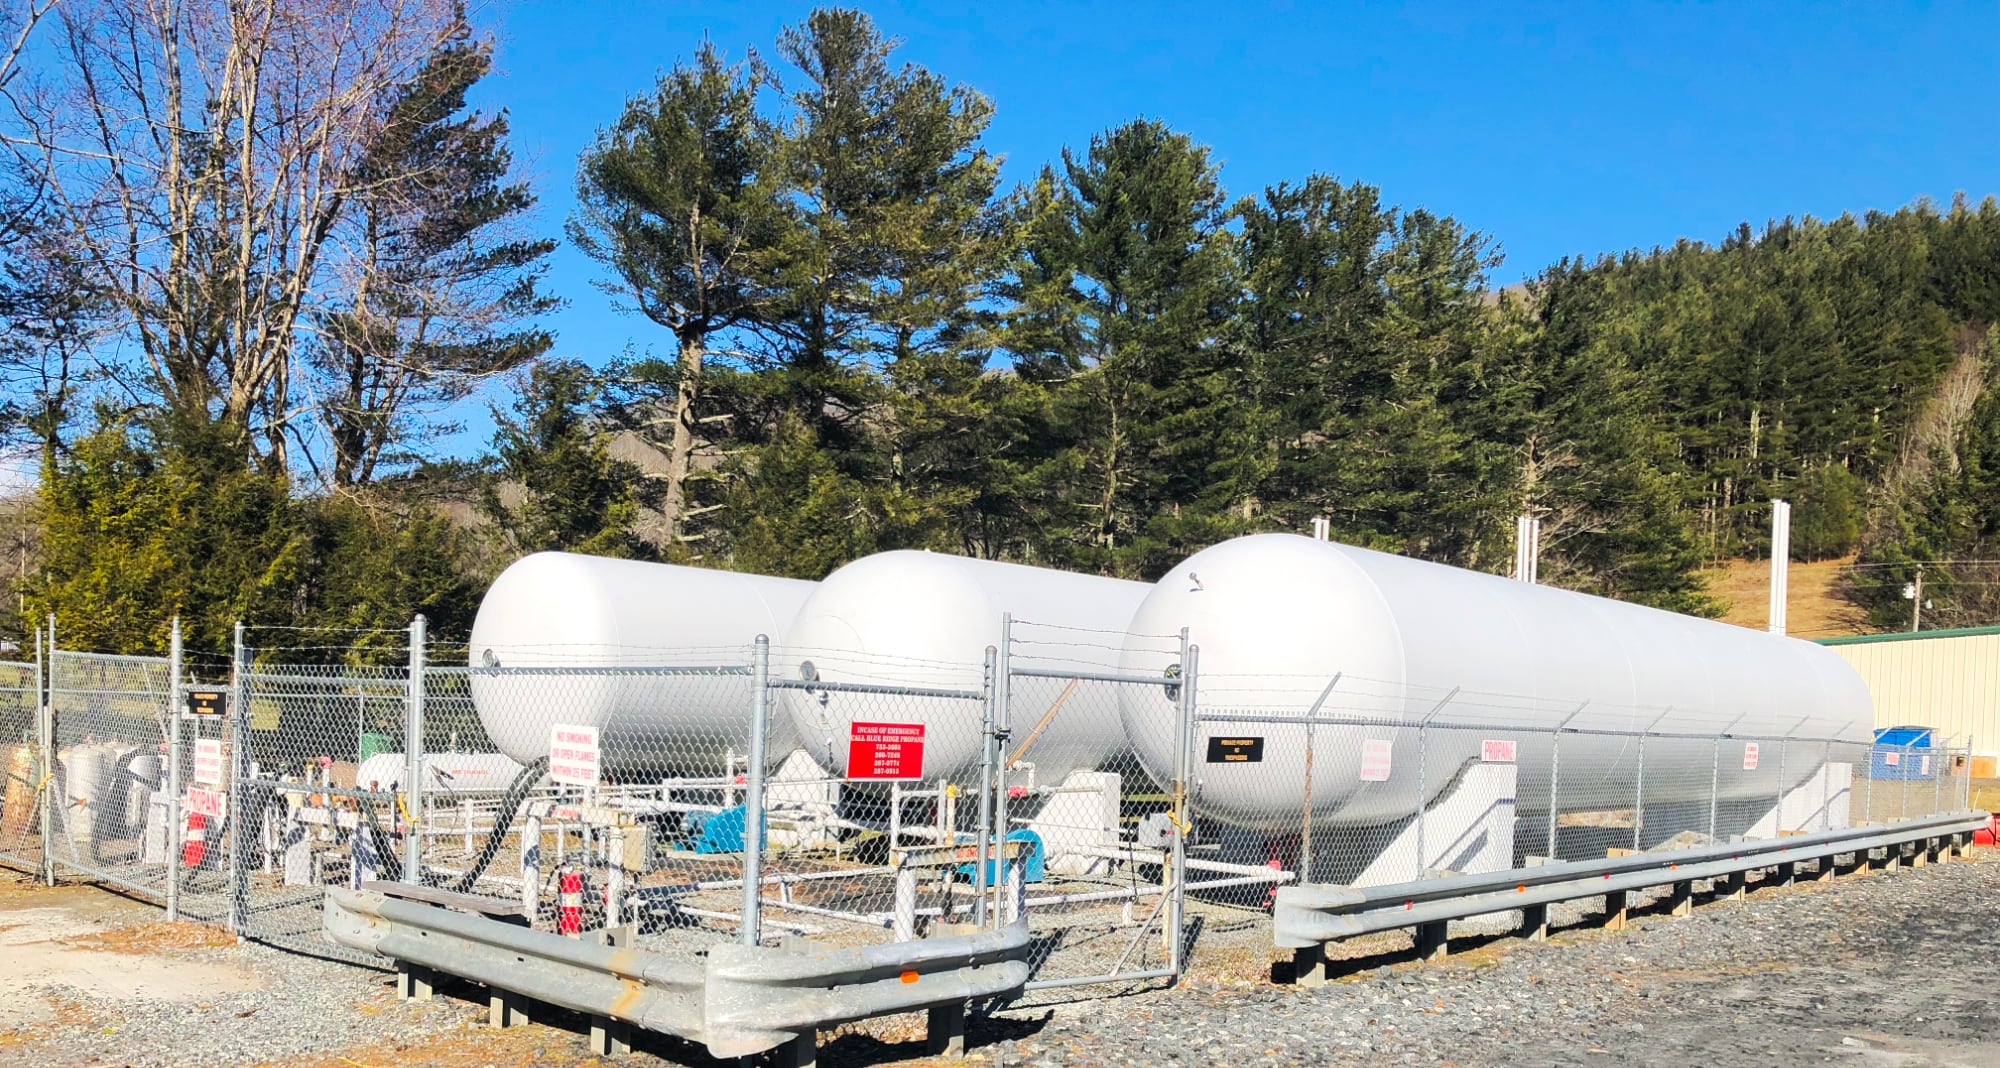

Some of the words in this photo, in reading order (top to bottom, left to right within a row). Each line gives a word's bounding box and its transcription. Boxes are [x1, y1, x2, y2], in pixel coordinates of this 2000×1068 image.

[557, 731, 564, 742] NO
[566, 732, 592, 744] SMOKING
[857, 726, 878, 734] INCASE
[887, 727, 920, 735] EMERGENCY
[851, 734, 865, 742] CALL
[882, 735, 899, 743] RIDGE
[552, 748, 559, 758] OR
[560, 748, 574, 760] OPEN
[575, 750, 595, 763] FLAMES
[1484, 741, 1514, 760] PROPANE
[551, 765, 571, 777] WITHIN
[581, 768, 595, 780] FEET
[189, 788, 222, 817] PROPANE
